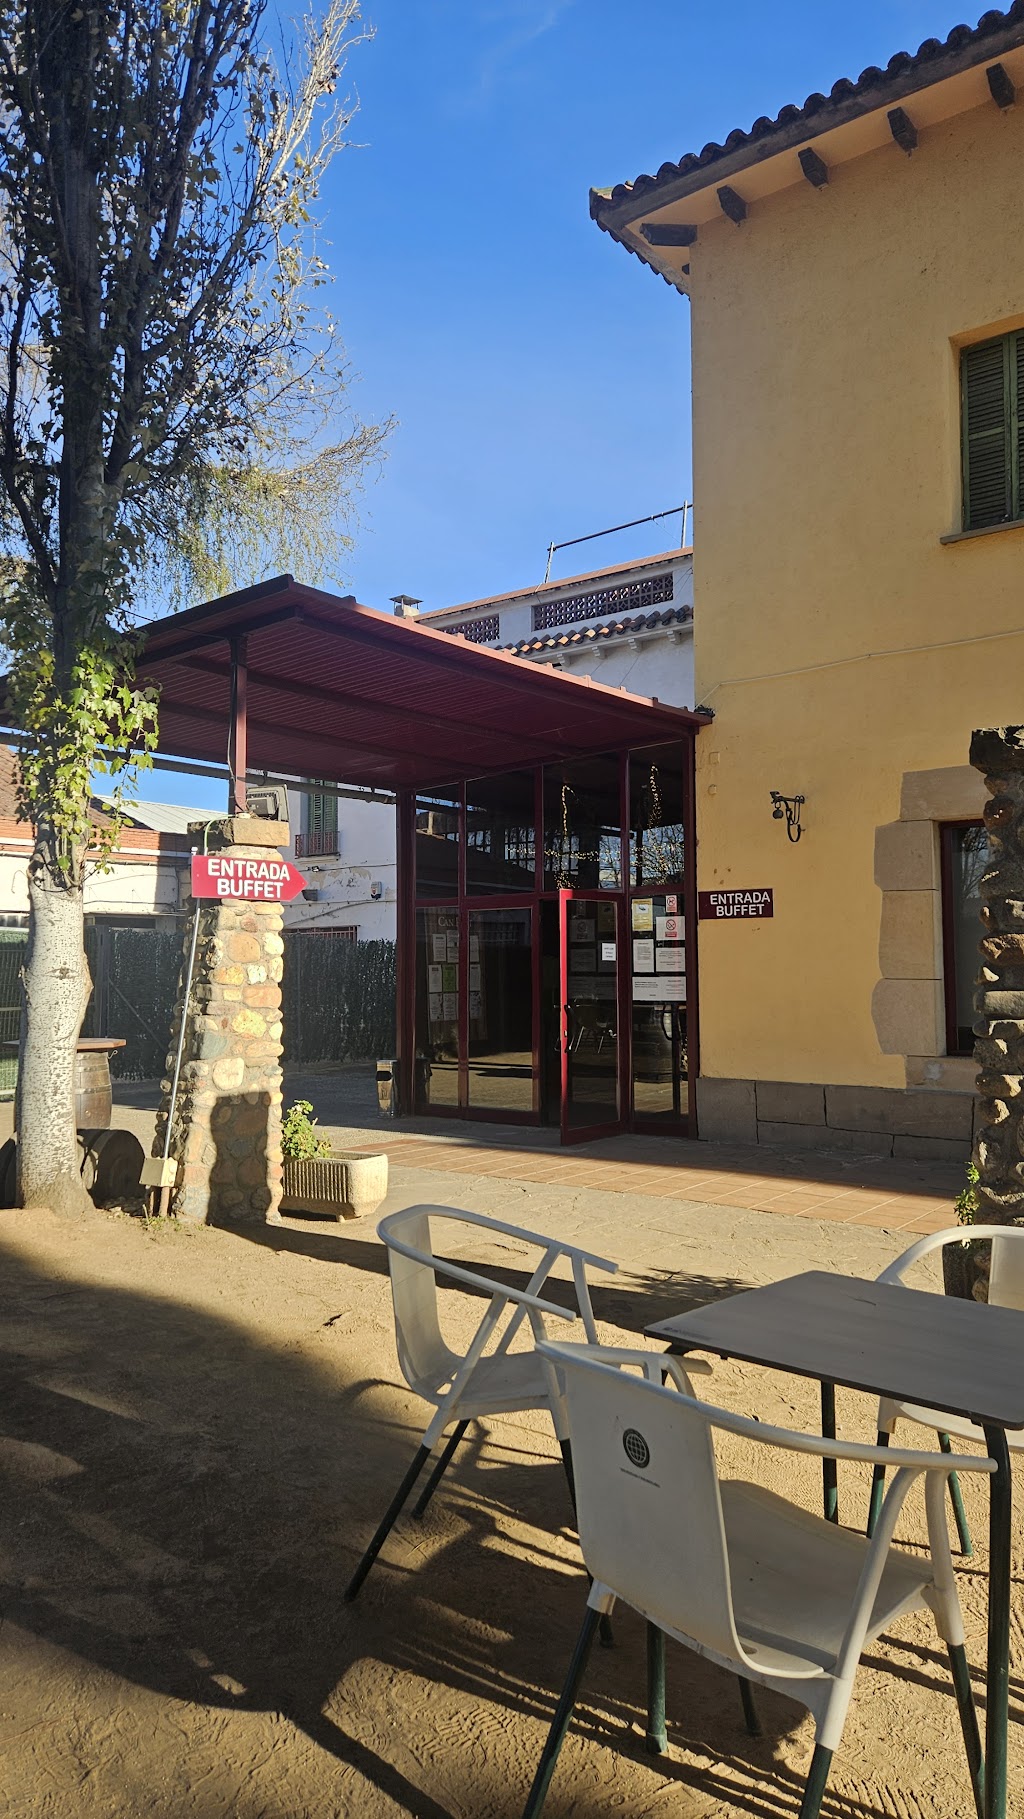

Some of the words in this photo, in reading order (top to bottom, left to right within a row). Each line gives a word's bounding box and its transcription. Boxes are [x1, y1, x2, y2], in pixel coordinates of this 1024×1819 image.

[207, 859, 291, 881] ENTRADA
[217, 878, 284, 898] BUFFET
[710, 891, 771, 905] ENTRADA
[716, 904, 765, 917] BUFFET
